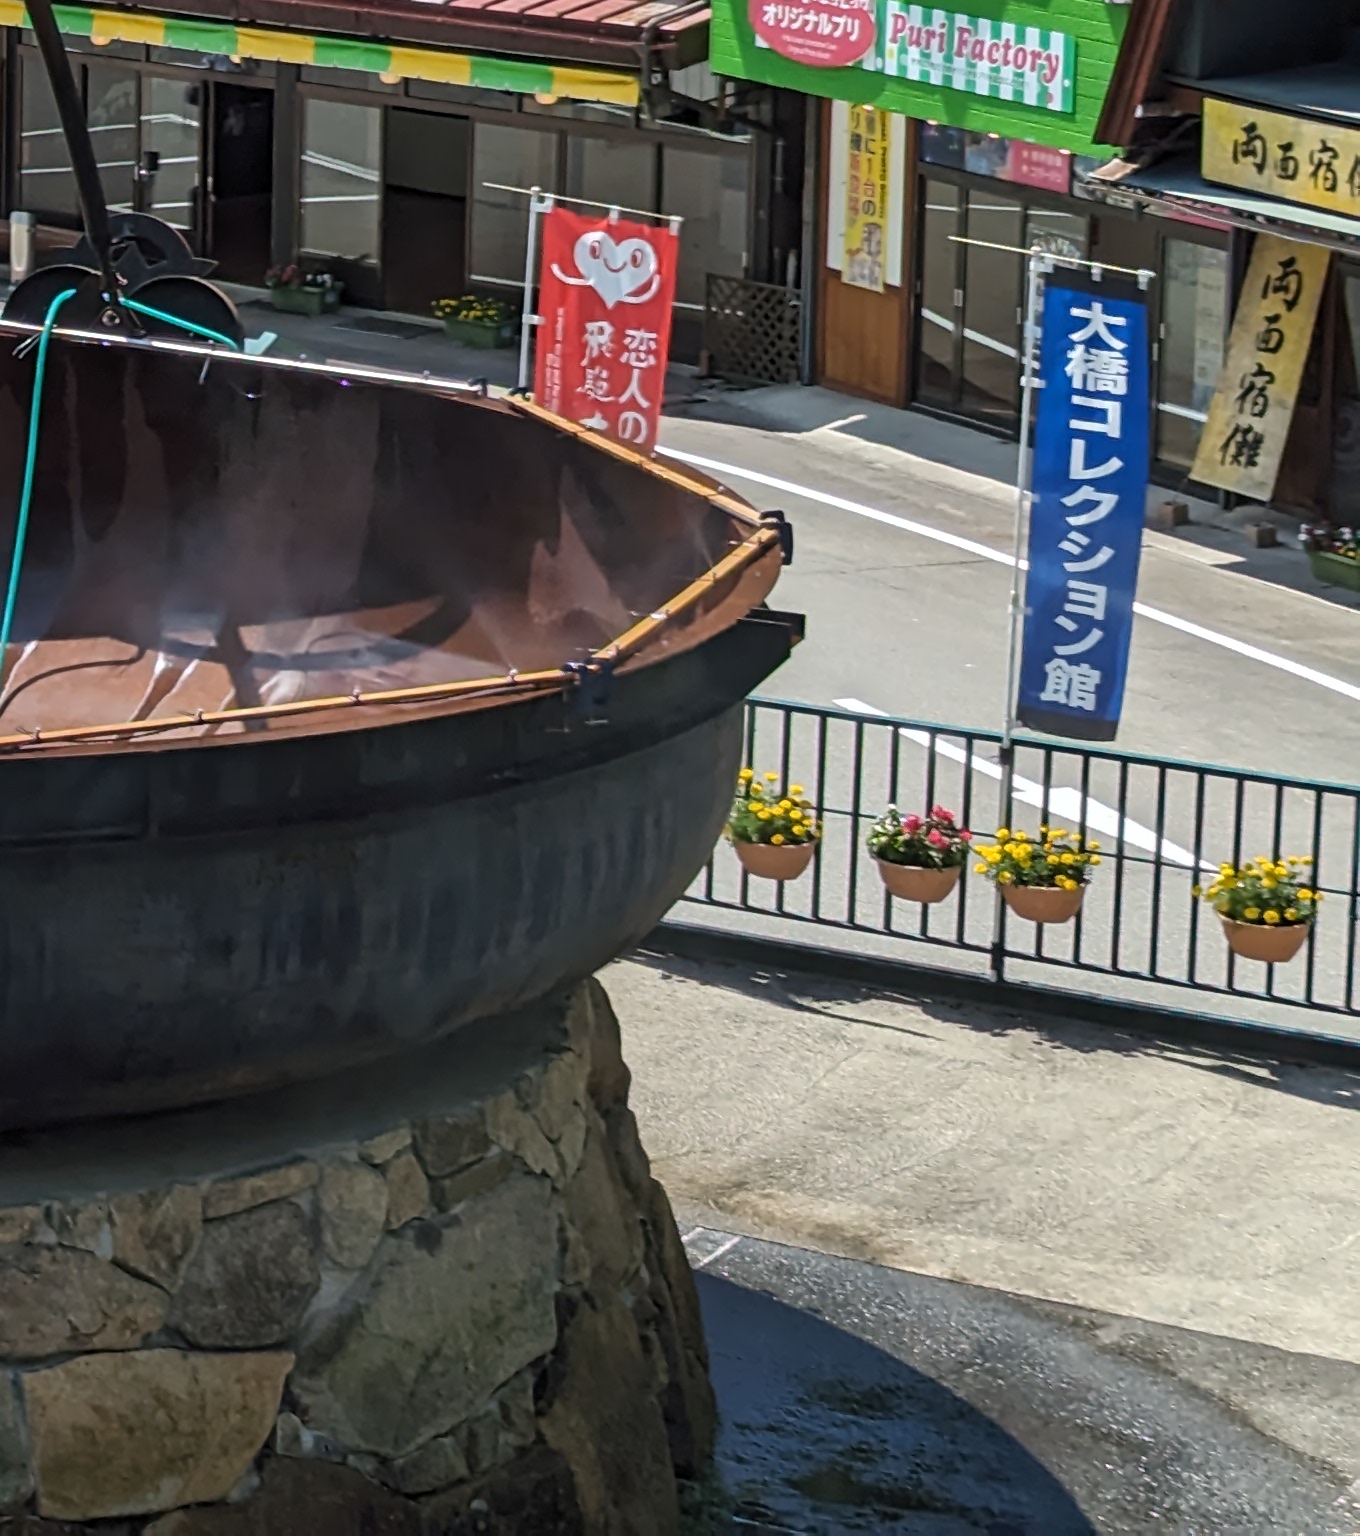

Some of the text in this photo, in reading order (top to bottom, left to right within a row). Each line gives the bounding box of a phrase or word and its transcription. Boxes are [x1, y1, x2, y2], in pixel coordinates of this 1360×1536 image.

[889, 13, 947, 54] Puri
[954, 26, 1060, 84] Factory
[617, 328, 659, 444] 恋人の
[1039, 301, 1130, 713] 大橋コレクション館
